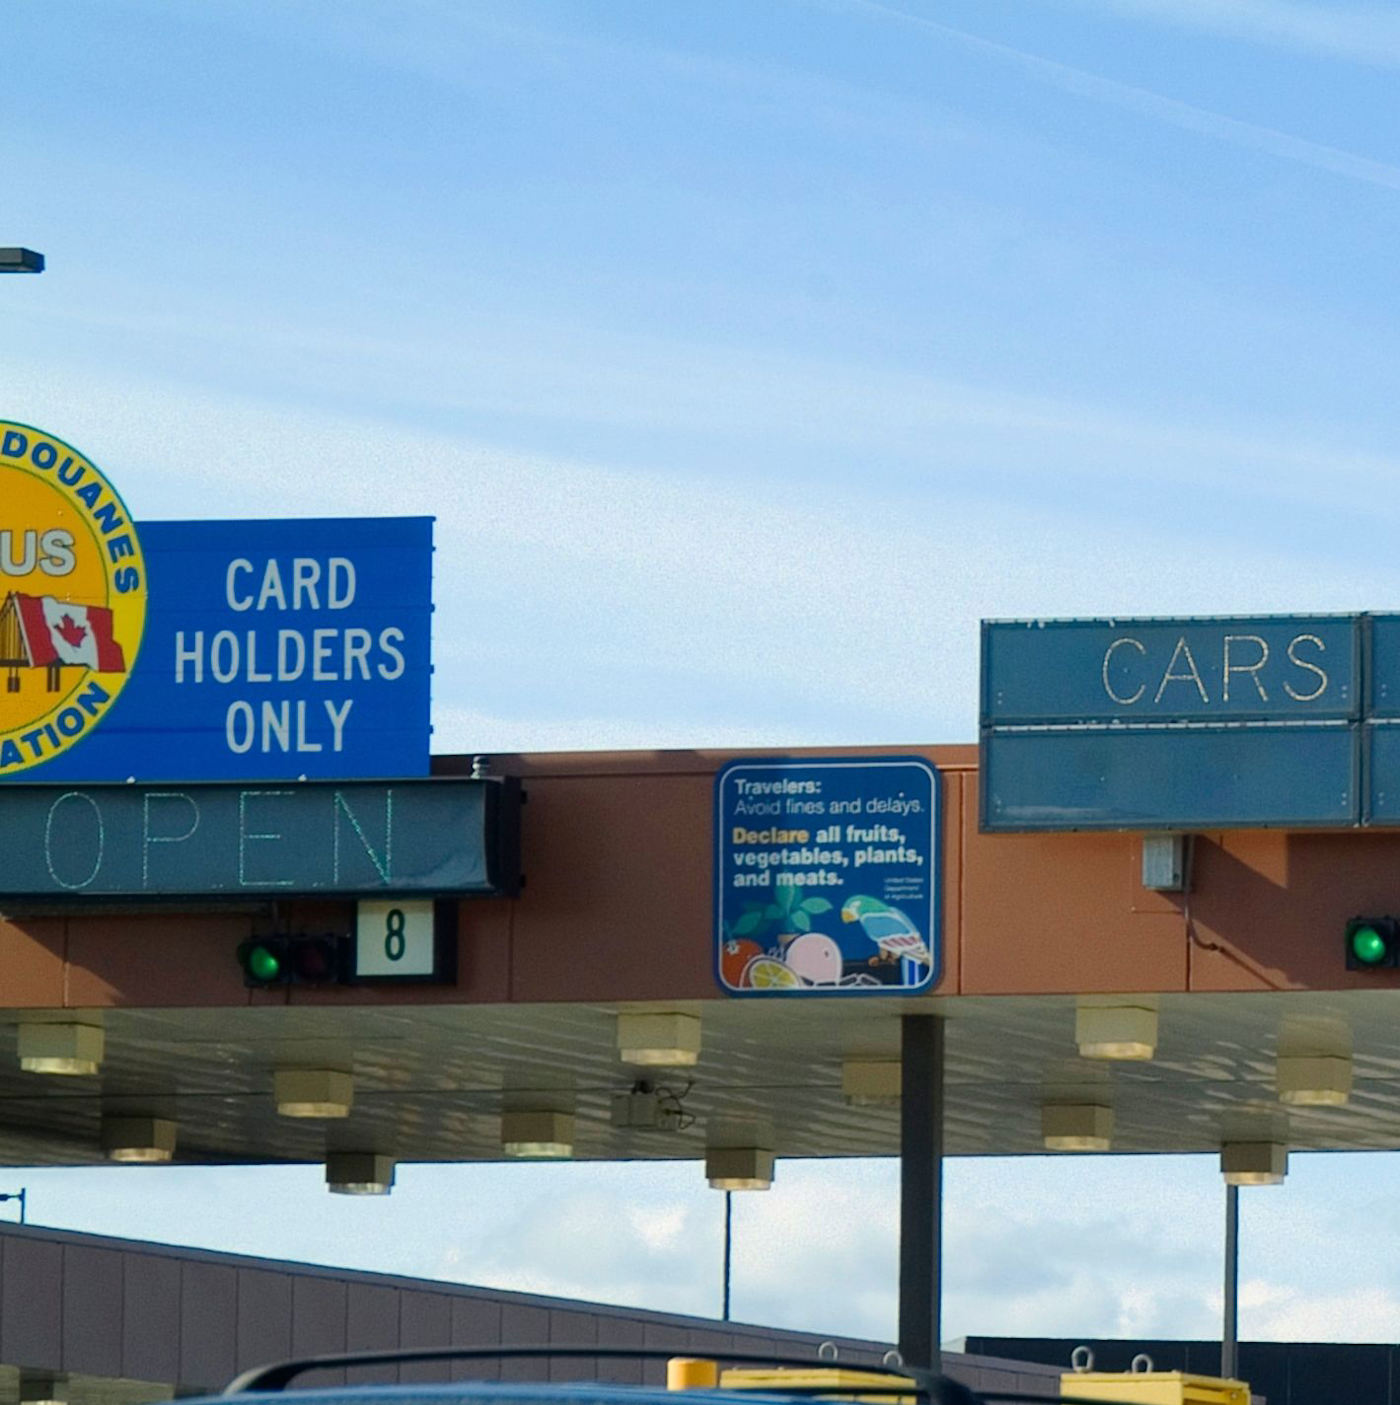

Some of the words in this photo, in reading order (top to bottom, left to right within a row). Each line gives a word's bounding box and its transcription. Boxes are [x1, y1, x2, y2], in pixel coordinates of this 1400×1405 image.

[1, 431, 139, 593] DOUANES
[226, 557, 356, 611] CARD
[175, 628, 405, 683] HOLDERS
[1101, 634, 1328, 704] CARS
[225, 700, 353, 754] ONLY
[734, 778, 822, 794] Travelers:
[734, 799, 781, 815] Avoid
[786, 798, 824, 814] fines
[829, 797, 861, 813] and
[866, 797, 924, 816] delays.
[44, 789, 393, 889] OPEN
[732, 827, 810, 844] Declare
[816, 826, 840, 842] all
[846, 824, 906, 843] fruits,
[733, 847, 849, 868] vegetables,
[854, 846, 923, 867] plants,
[733, 870, 770, 886] and
[776, 870, 844, 886] meats.
[384, 908, 405, 961] 8
